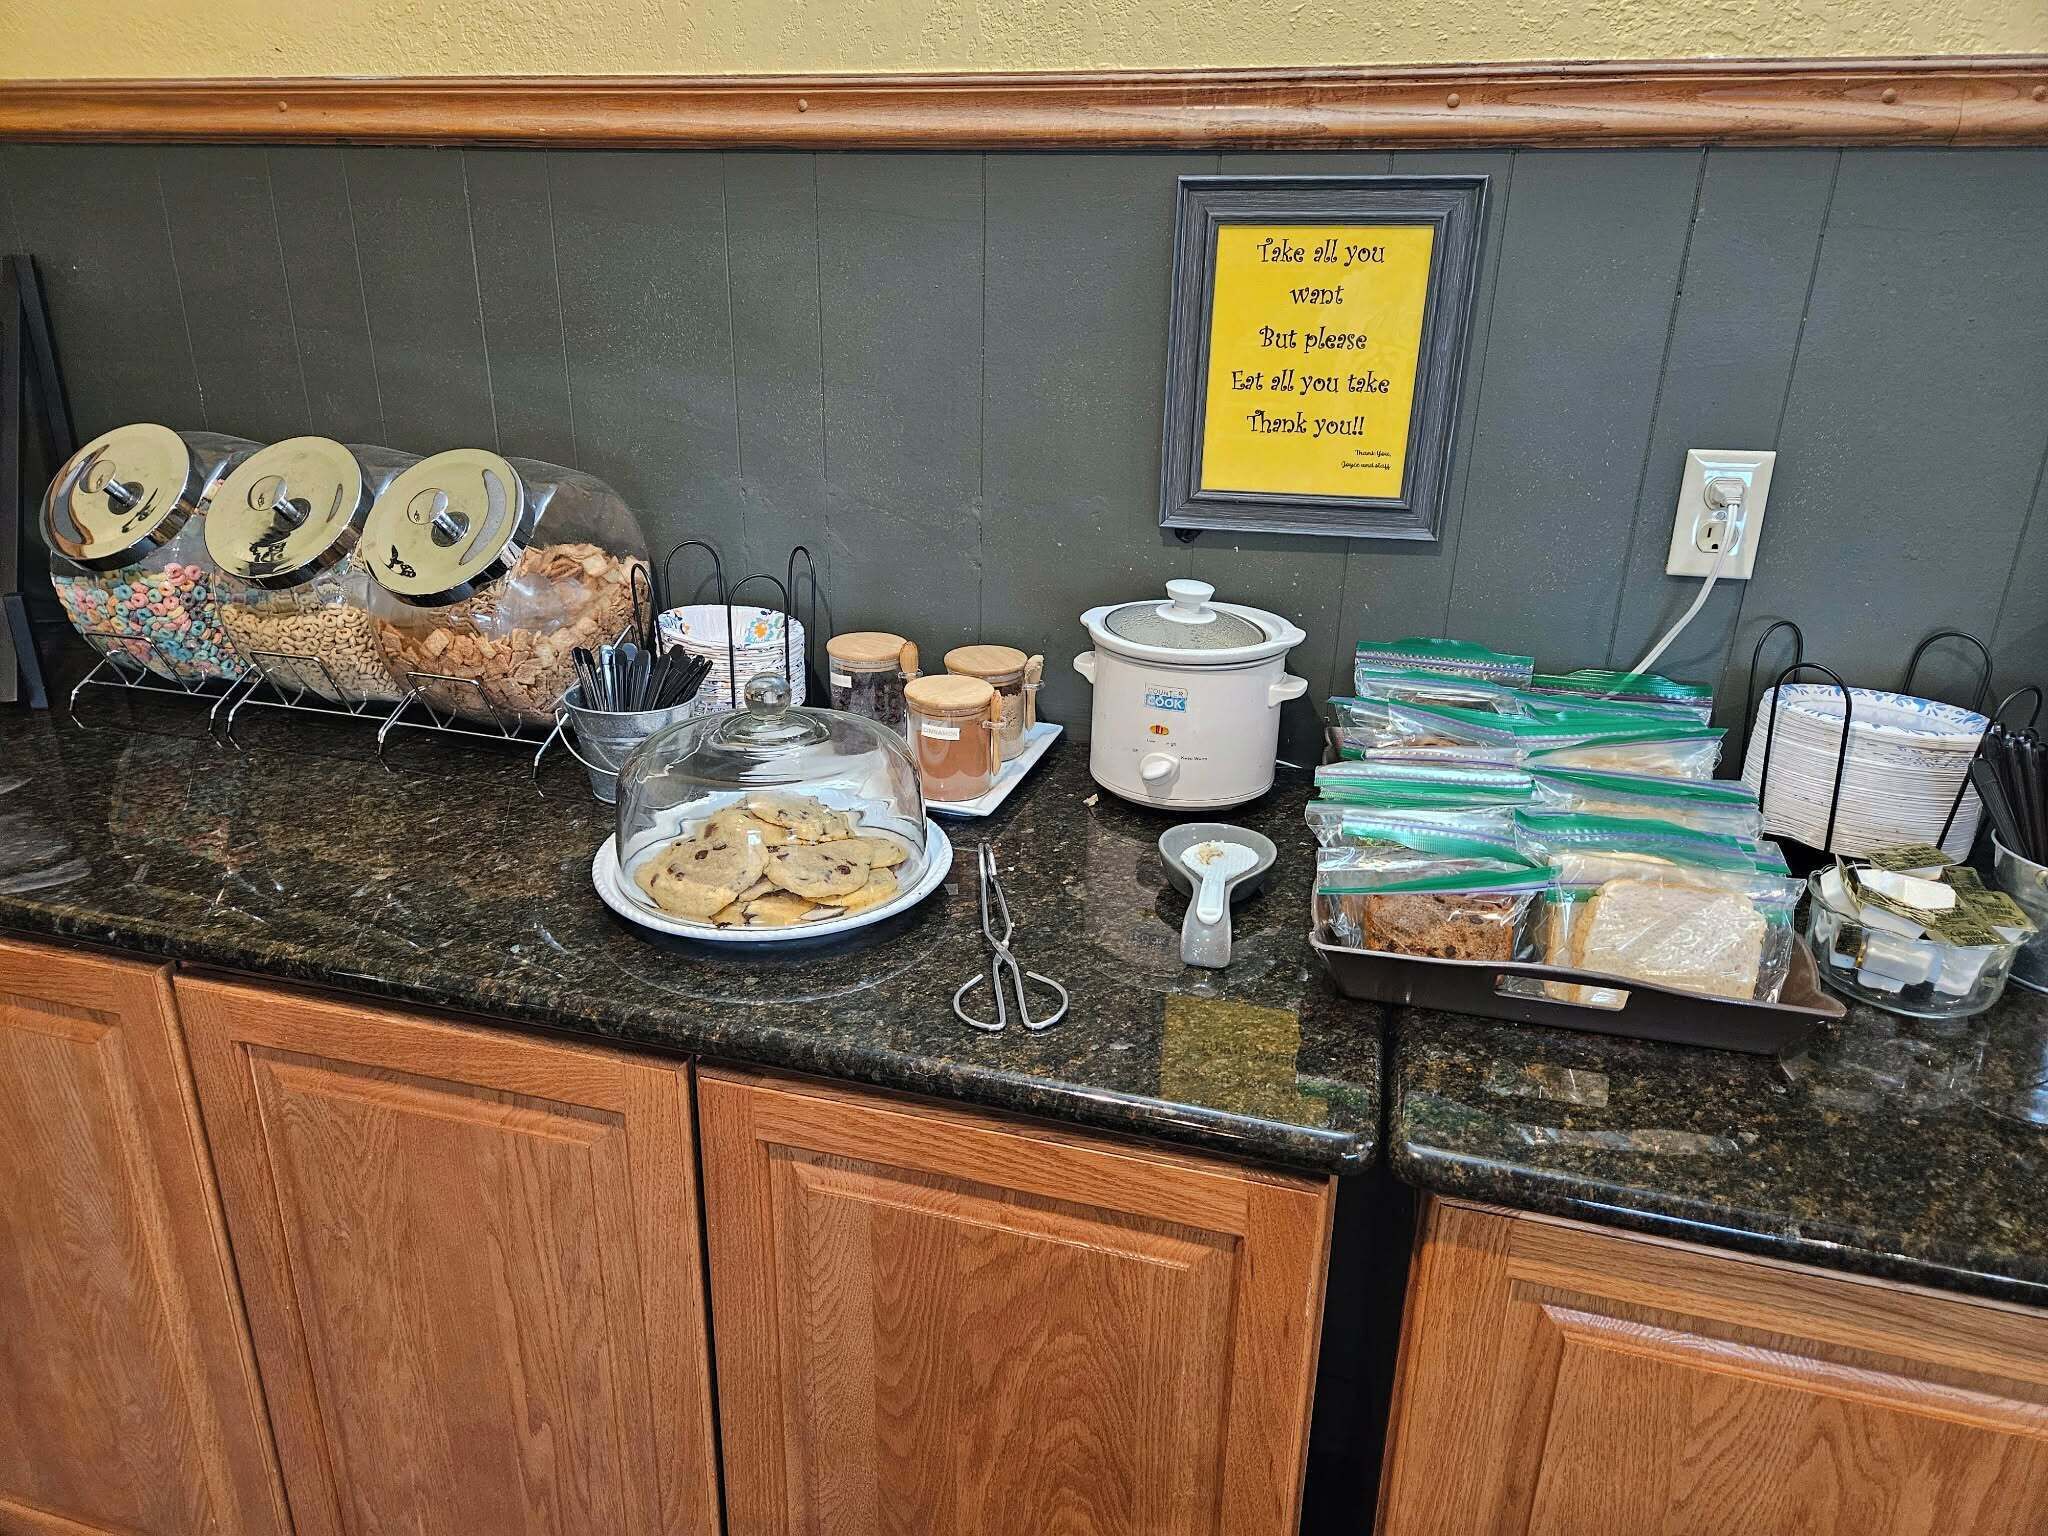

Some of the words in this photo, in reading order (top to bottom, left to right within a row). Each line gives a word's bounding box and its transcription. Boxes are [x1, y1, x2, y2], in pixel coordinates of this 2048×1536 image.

[1256, 237, 1305, 263] Take
[1313, 238, 1338, 264] all
[1343, 244, 1385, 267] you
[1289, 285, 1344, 305] want
[1258, 325, 1298, 349] But
[1303, 325, 1368, 354] please
[1231, 370, 1264, 391] Eat
[1270, 369, 1295, 392] all
[1299, 375, 1339, 396] you
[1347, 370, 1390, 394] take
[1246, 409, 1308, 434] Thank
[1312, 415, 1364, 439] you!!
[1148, 694, 1184, 710] COOK
